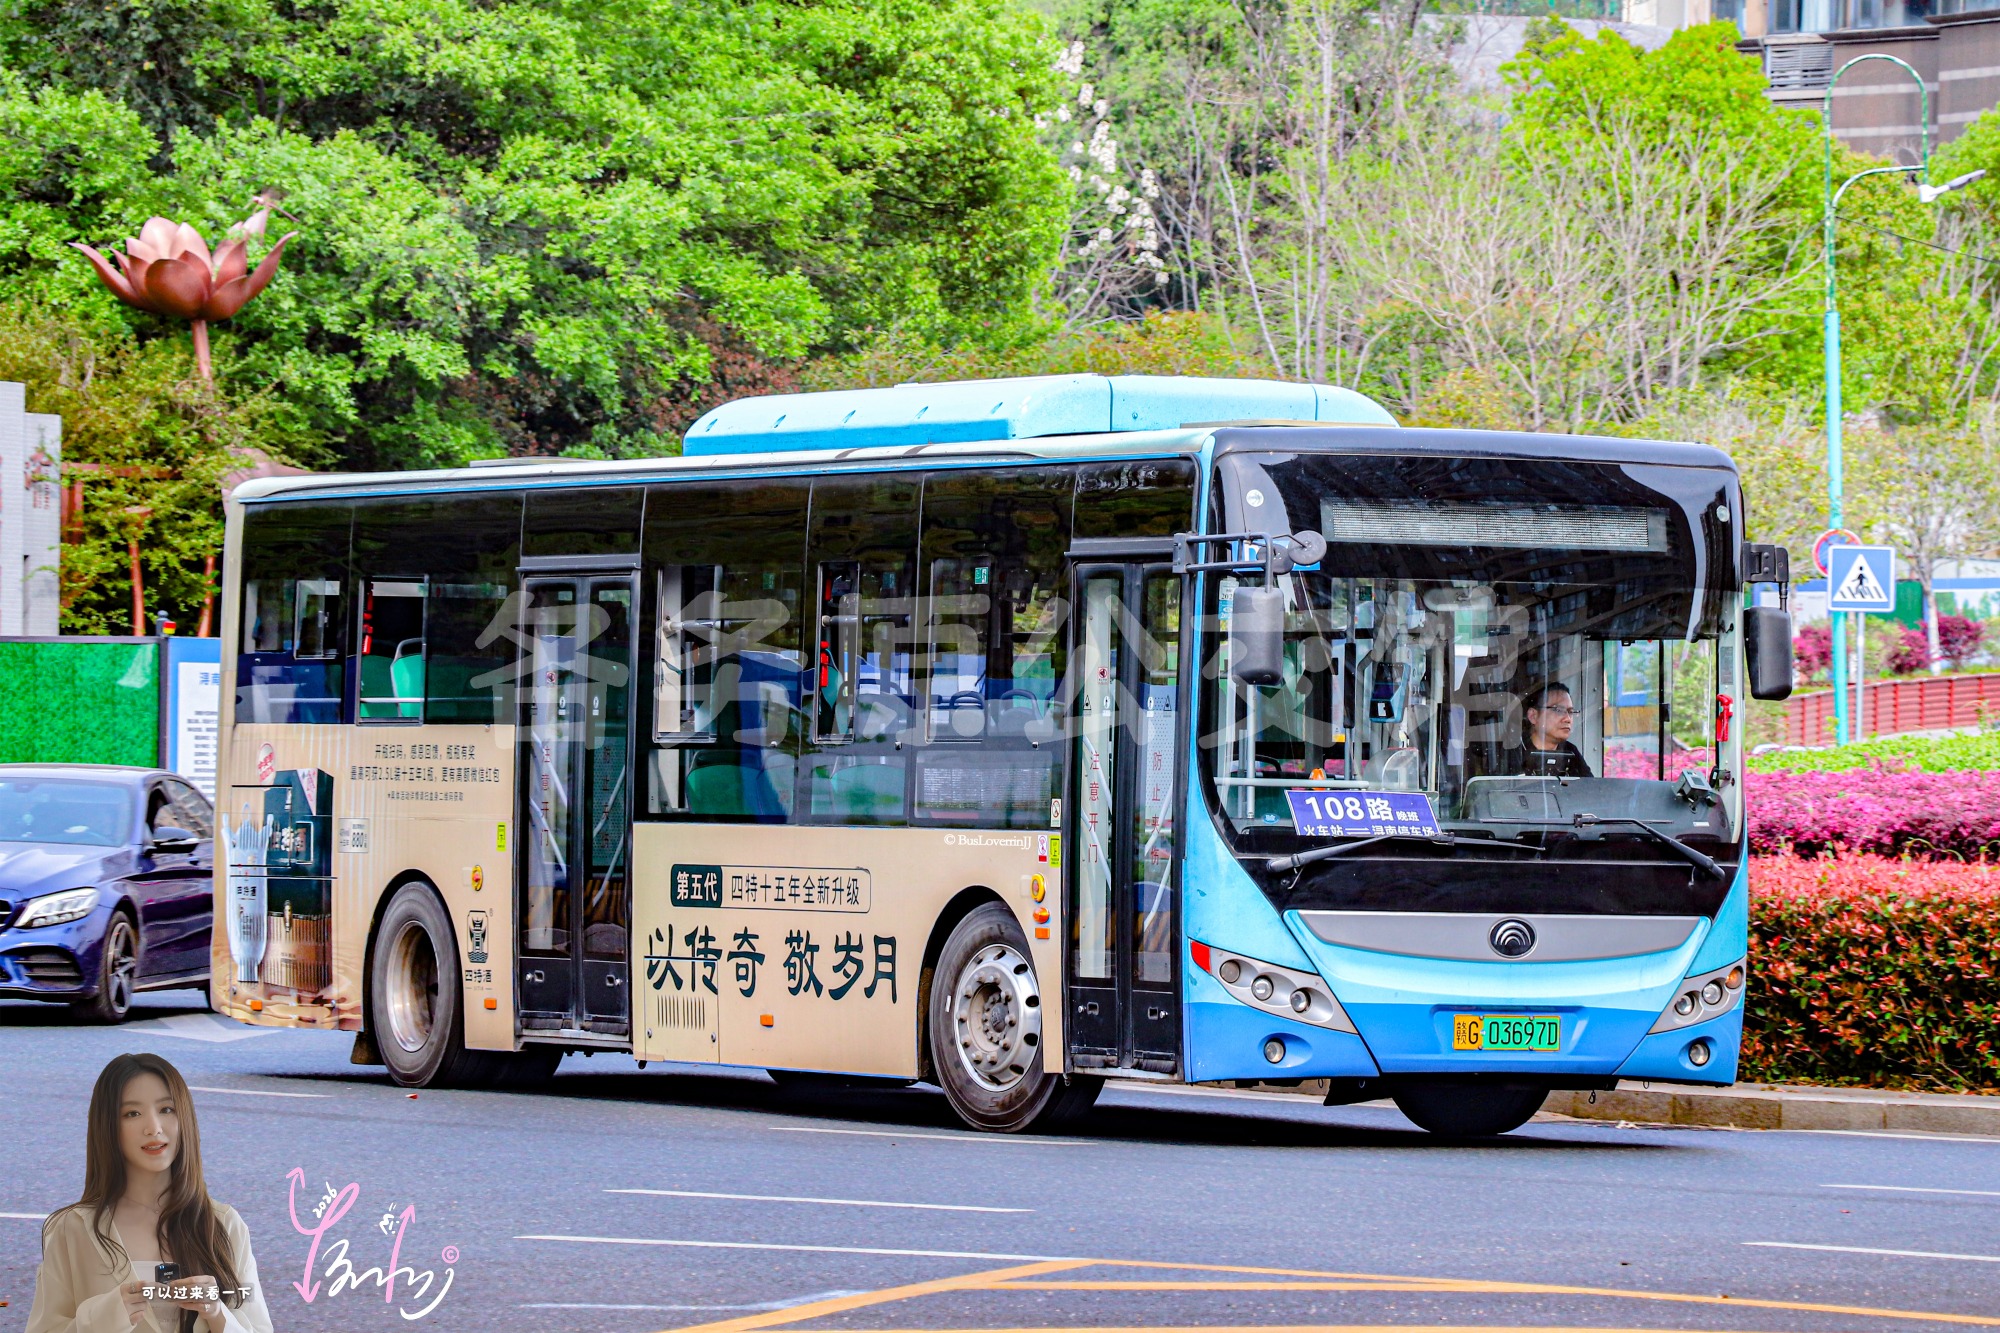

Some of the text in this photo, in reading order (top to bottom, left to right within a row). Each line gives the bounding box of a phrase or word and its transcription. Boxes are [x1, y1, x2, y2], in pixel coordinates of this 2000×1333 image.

[1088, 751, 1099, 863] 注意开门
[1151, 751, 1162, 866] 防止夹伤
[1305, 797, 1420, 822] 108路 晚班
[1303, 824, 1344, 836] 火车站
[676, 871, 718, 902] 第五代
[731, 873, 860, 906] 四特十五年全新升级
[646, 923, 898, 1004] 以传奇 敬岁月
[1456, 1021, 1558, 1046] 赣G 03697D
